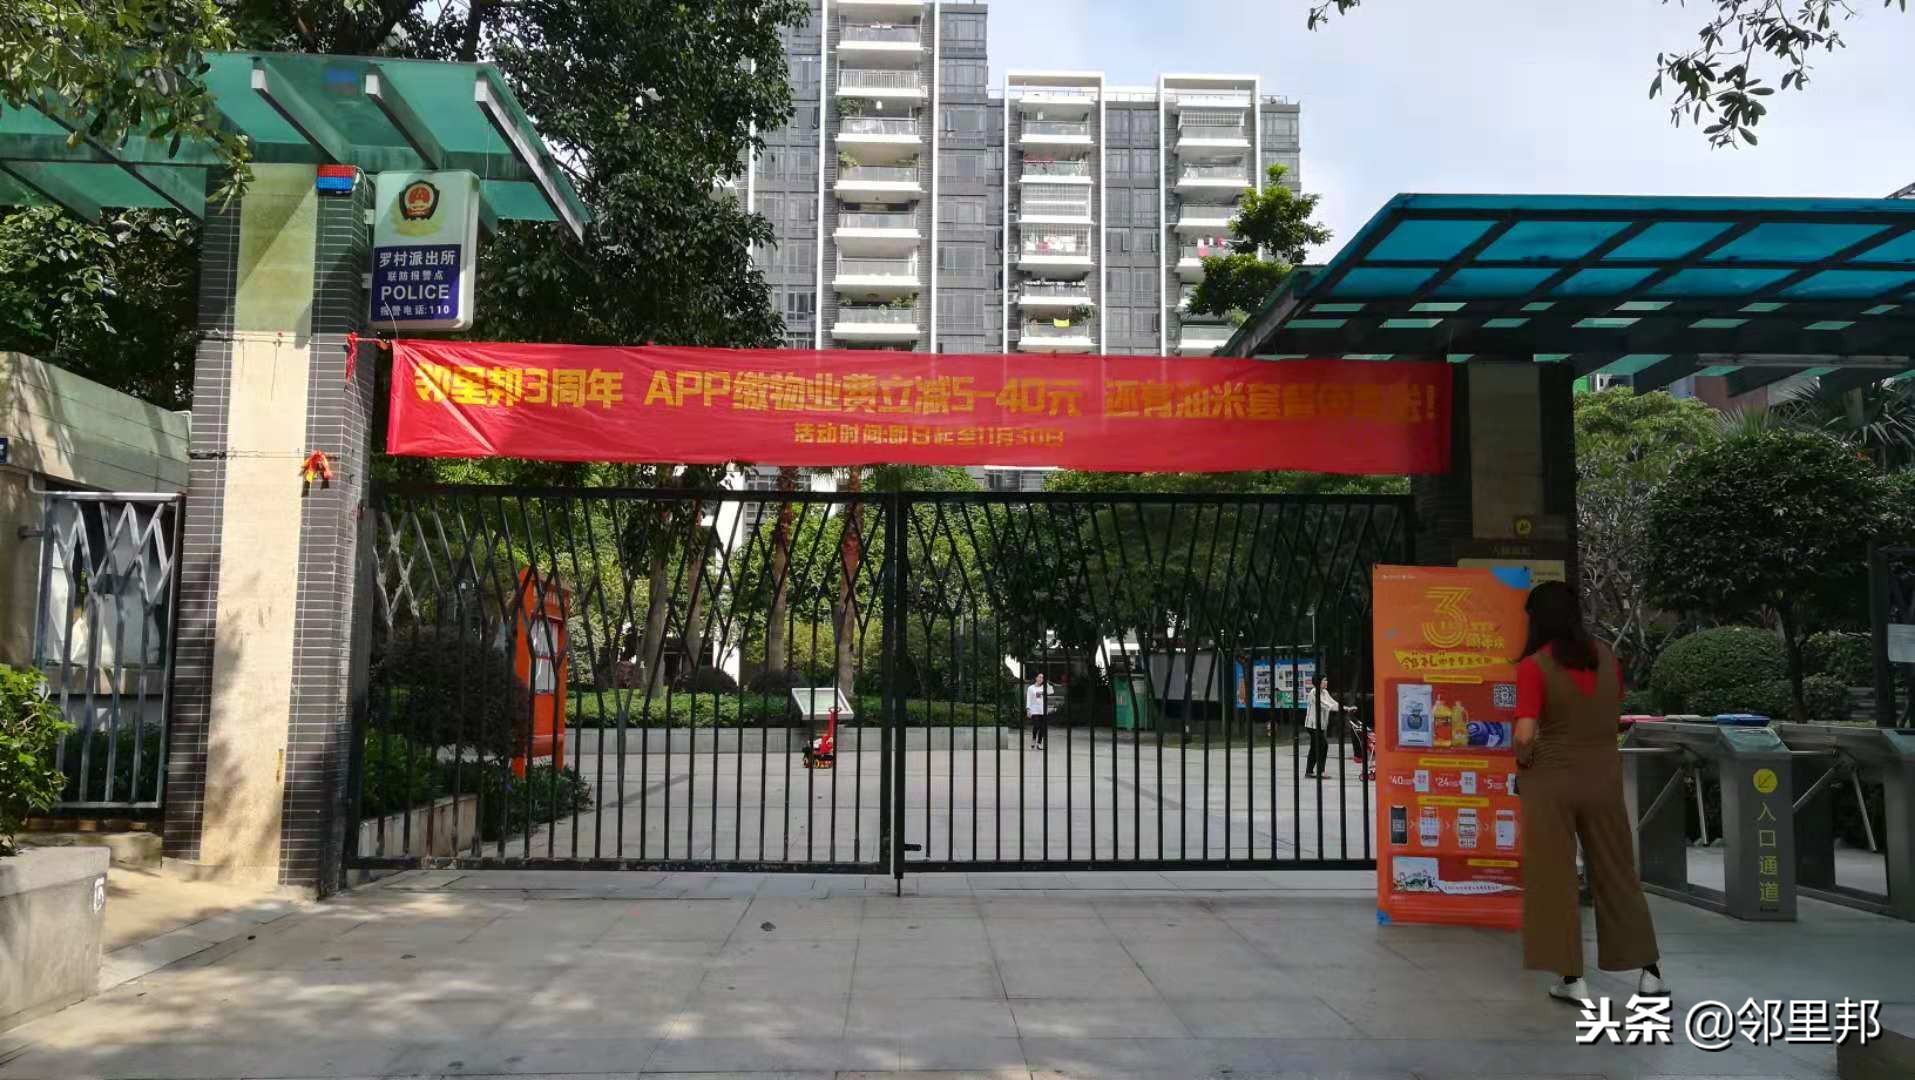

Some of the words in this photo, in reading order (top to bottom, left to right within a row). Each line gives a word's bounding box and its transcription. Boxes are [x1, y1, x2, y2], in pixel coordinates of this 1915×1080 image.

[379, 250, 455, 268] 罗村派出所
[381, 284, 450, 301] POLICE
[415, 360, 624, 409] 邻里邦3周年
[1757, 801, 1780, 903] 入口通道
